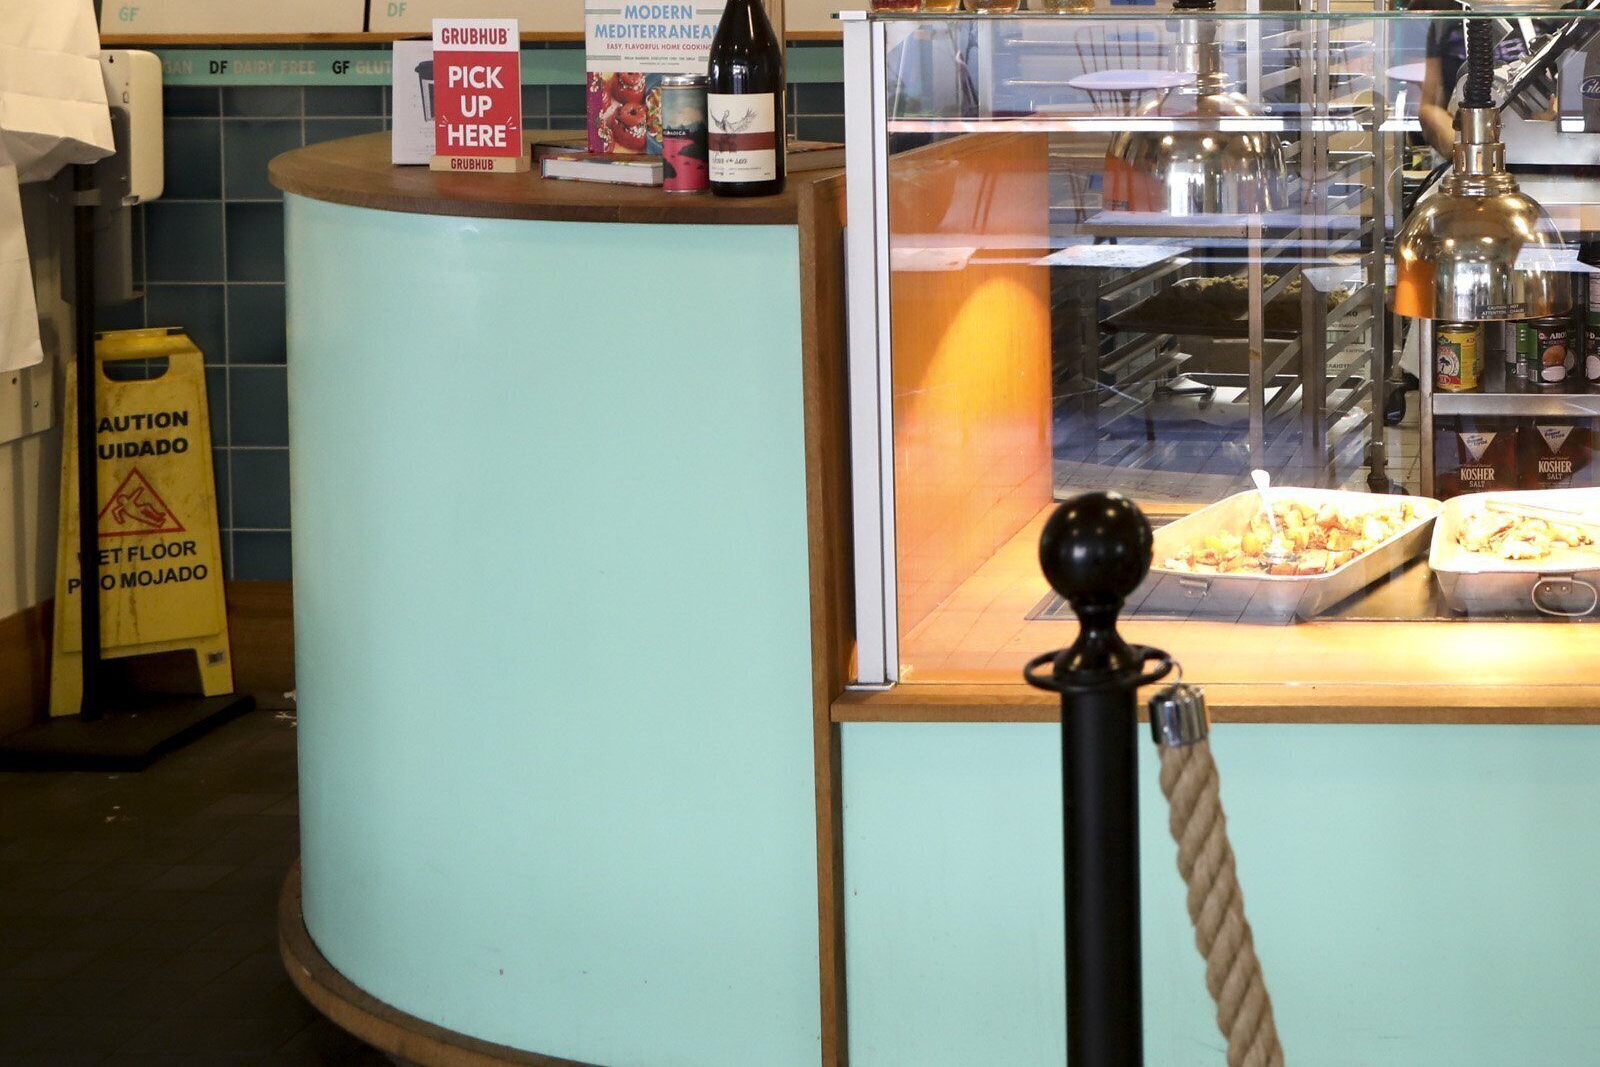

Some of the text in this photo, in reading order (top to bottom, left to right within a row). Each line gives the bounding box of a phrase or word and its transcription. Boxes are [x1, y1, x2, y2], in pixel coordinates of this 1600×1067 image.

[625, 5, 693, 19] MODERN
[442, 28, 507, 45] GRUBHUB
[449, 66, 504, 89] PICK
[460, 95, 492, 117] UP
[448, 124, 506, 147] HERE
[451, 158, 493, 170] GRUBHUB
[98, 410, 188, 433] AUTION
[99, 437, 188, 460] UIDADO
[1461, 468, 1495, 480] KOSHER
[1539, 461, 1572, 473] KOSHER
[128, 541, 196, 563] FLOOR
[120, 565, 208, 589] MOJADO
